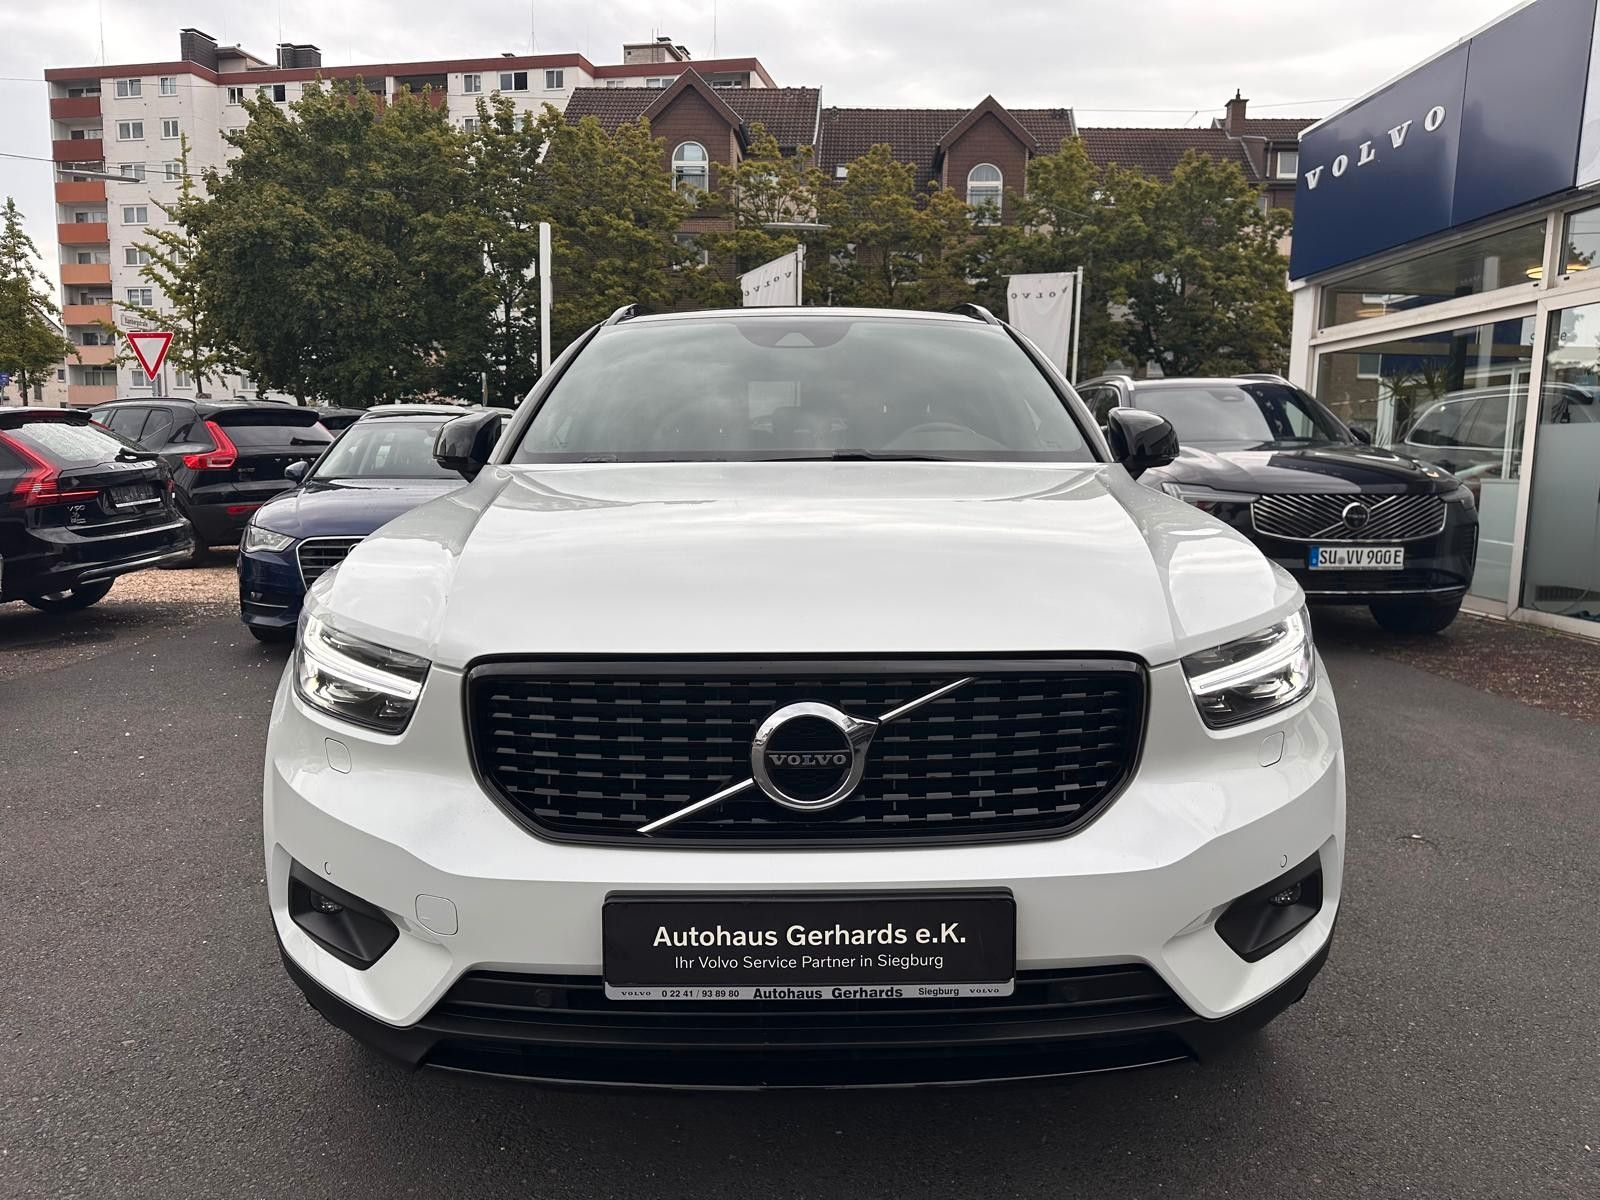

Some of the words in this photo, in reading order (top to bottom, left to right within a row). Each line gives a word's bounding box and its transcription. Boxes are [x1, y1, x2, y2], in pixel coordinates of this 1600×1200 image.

[1304, 105, 1446, 190] VOLVO
[1319, 549, 1338, 565] SU
[1347, 549, 1366, 565] VV
[768, 754, 847, 766] VOLVO
[653, 925, 778, 947] Autohaus
[786, 923, 908, 946] Gerhards
[915, 922, 966, 944] e.K.
[675, 956, 695, 969] Ihr
[698, 956, 739, 969] Volvo
[743, 956, 797, 969] Service
[802, 955, 856, 968] Partner
[860, 955, 873, 967] in
[877, 953, 944, 970] Siegburg
[661, 990, 668, 998] 0
[669, 990, 681, 998] 22
[682, 989, 694, 998] 41
[701, 989, 714, 998] 93
[715, 989, 727, 998] 89
[728, 989, 740, 998] 80
[753, 988, 823, 1000] Autohaus
[831, 986, 903, 999] Gerhards
[918, 987, 960, 997] Siegburg
